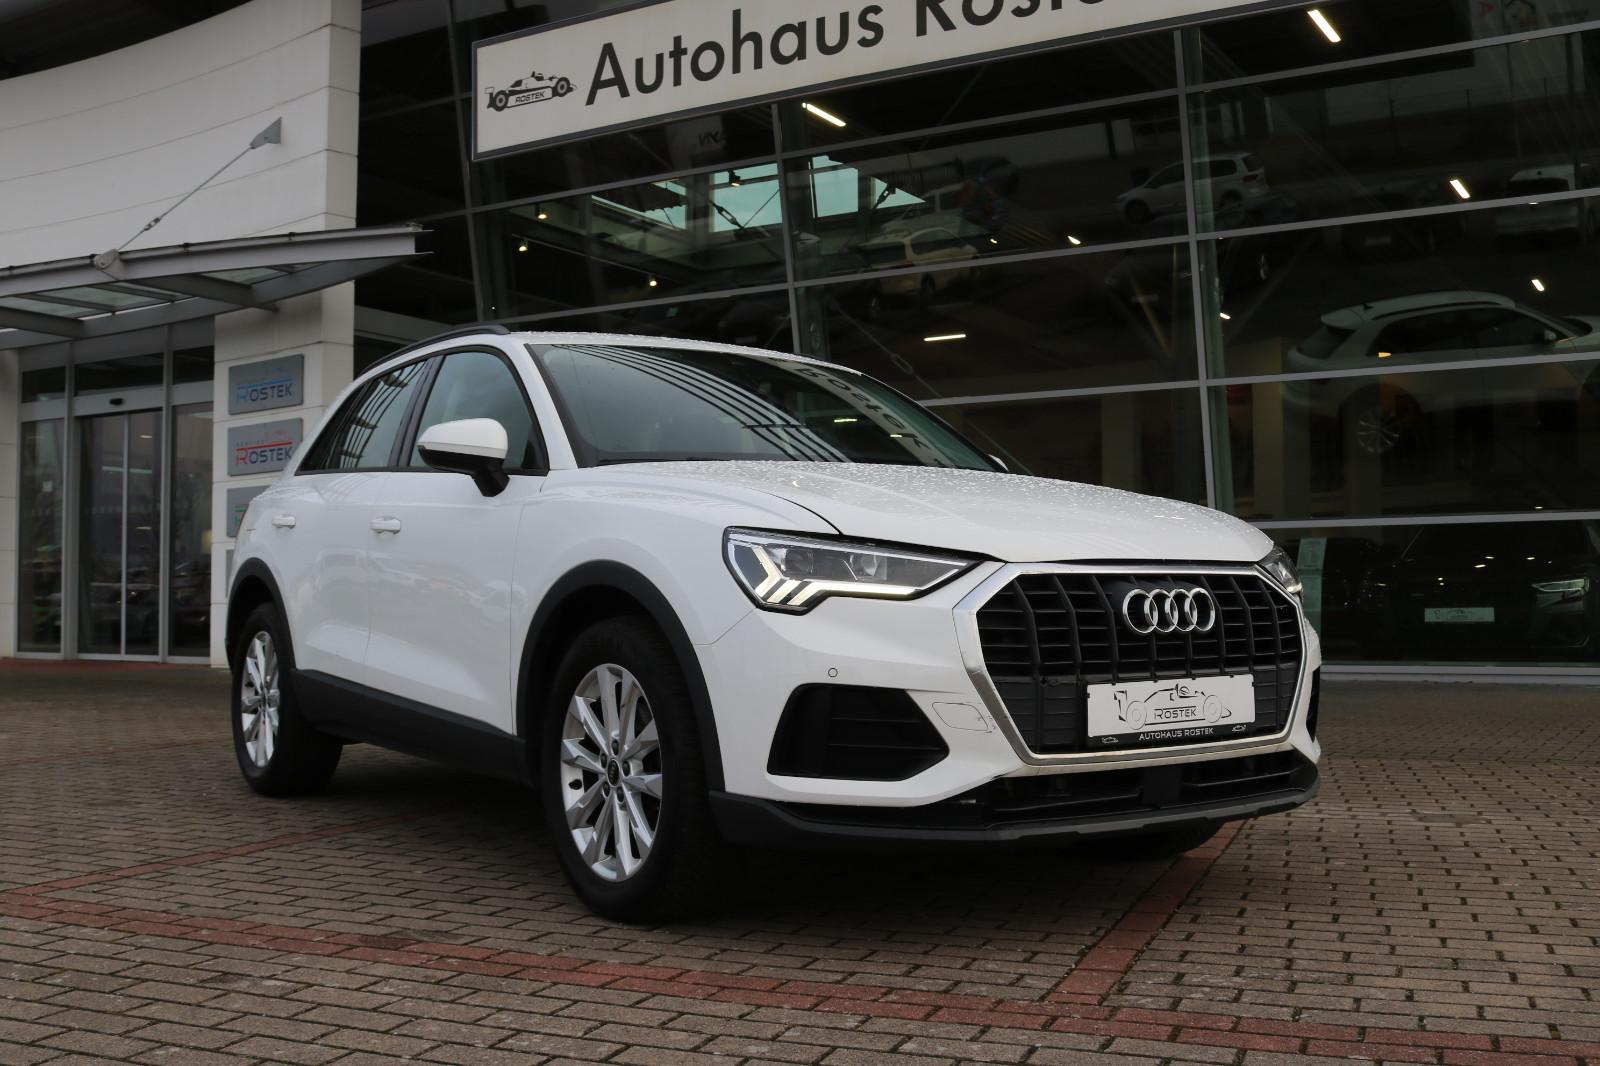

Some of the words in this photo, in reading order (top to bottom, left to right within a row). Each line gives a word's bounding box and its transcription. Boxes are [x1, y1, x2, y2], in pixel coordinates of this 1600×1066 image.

[584, 5, 884, 106] Autohaus
[514, 91, 545, 103] ROSTEK
[1139, 730, 1183, 740] AUTOHAUS
[1184, 727, 1214, 737] ROSTEK
